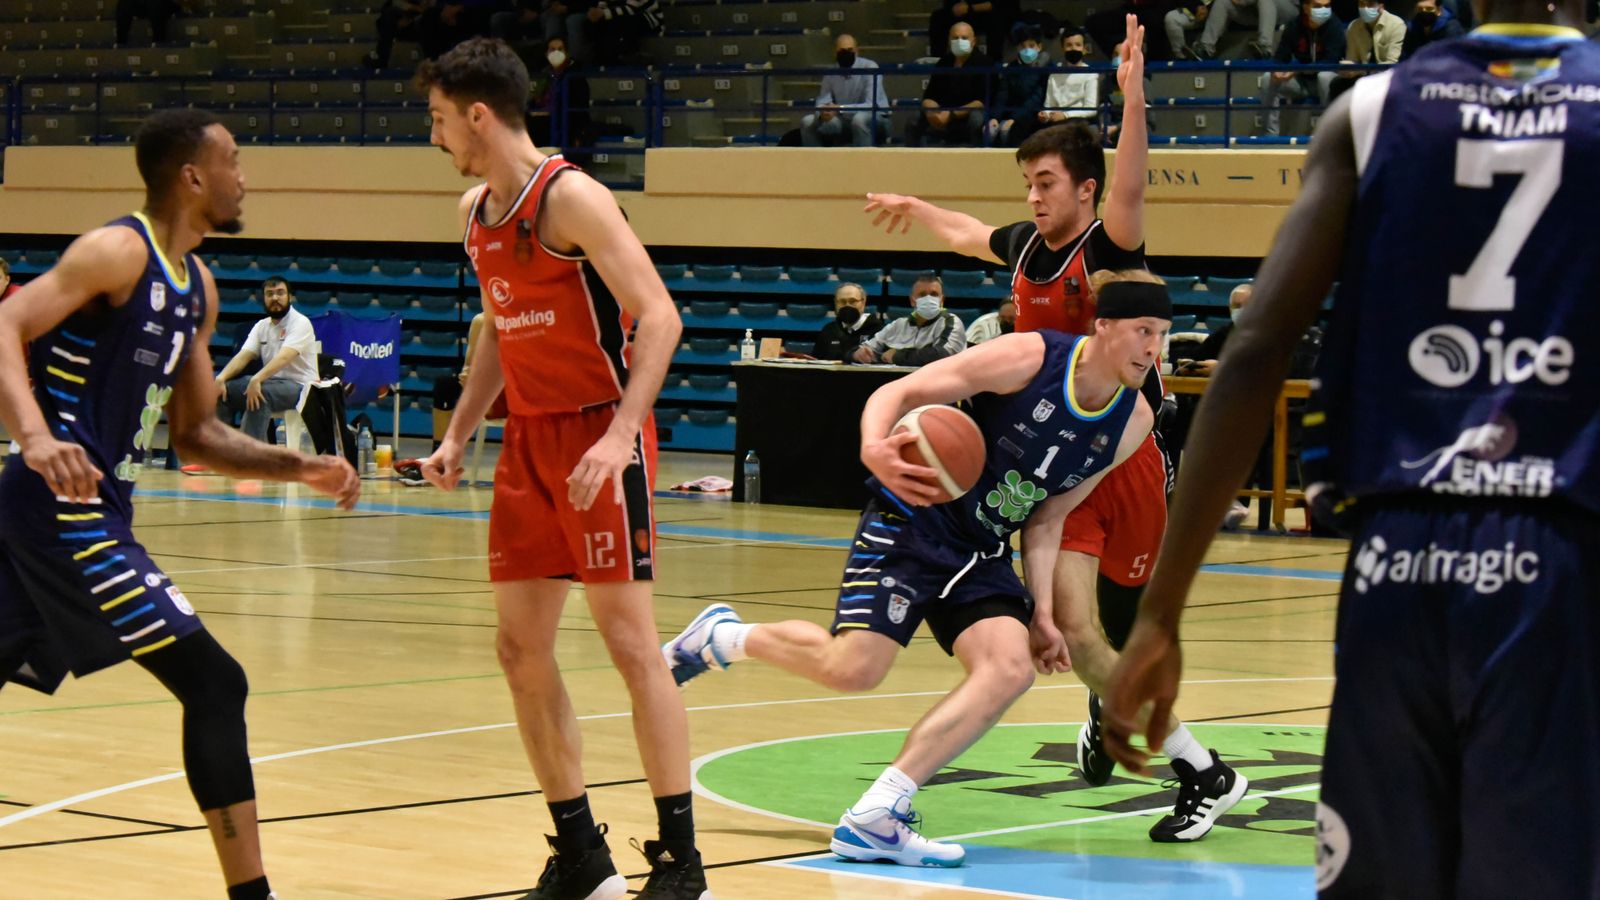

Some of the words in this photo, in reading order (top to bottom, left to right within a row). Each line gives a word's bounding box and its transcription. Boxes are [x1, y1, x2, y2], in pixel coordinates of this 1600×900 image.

[1420, 82, 1600, 107] mastehous
[1459, 103, 1568, 137] THIAM
[1447, 138, 1565, 311] 7
[349, 340, 393, 359] molten
[1483, 319, 1574, 386] ice
[1033, 445, 1060, 480] 1
[583, 531, 616, 569] 12
[1128, 552, 1149, 578] 5
